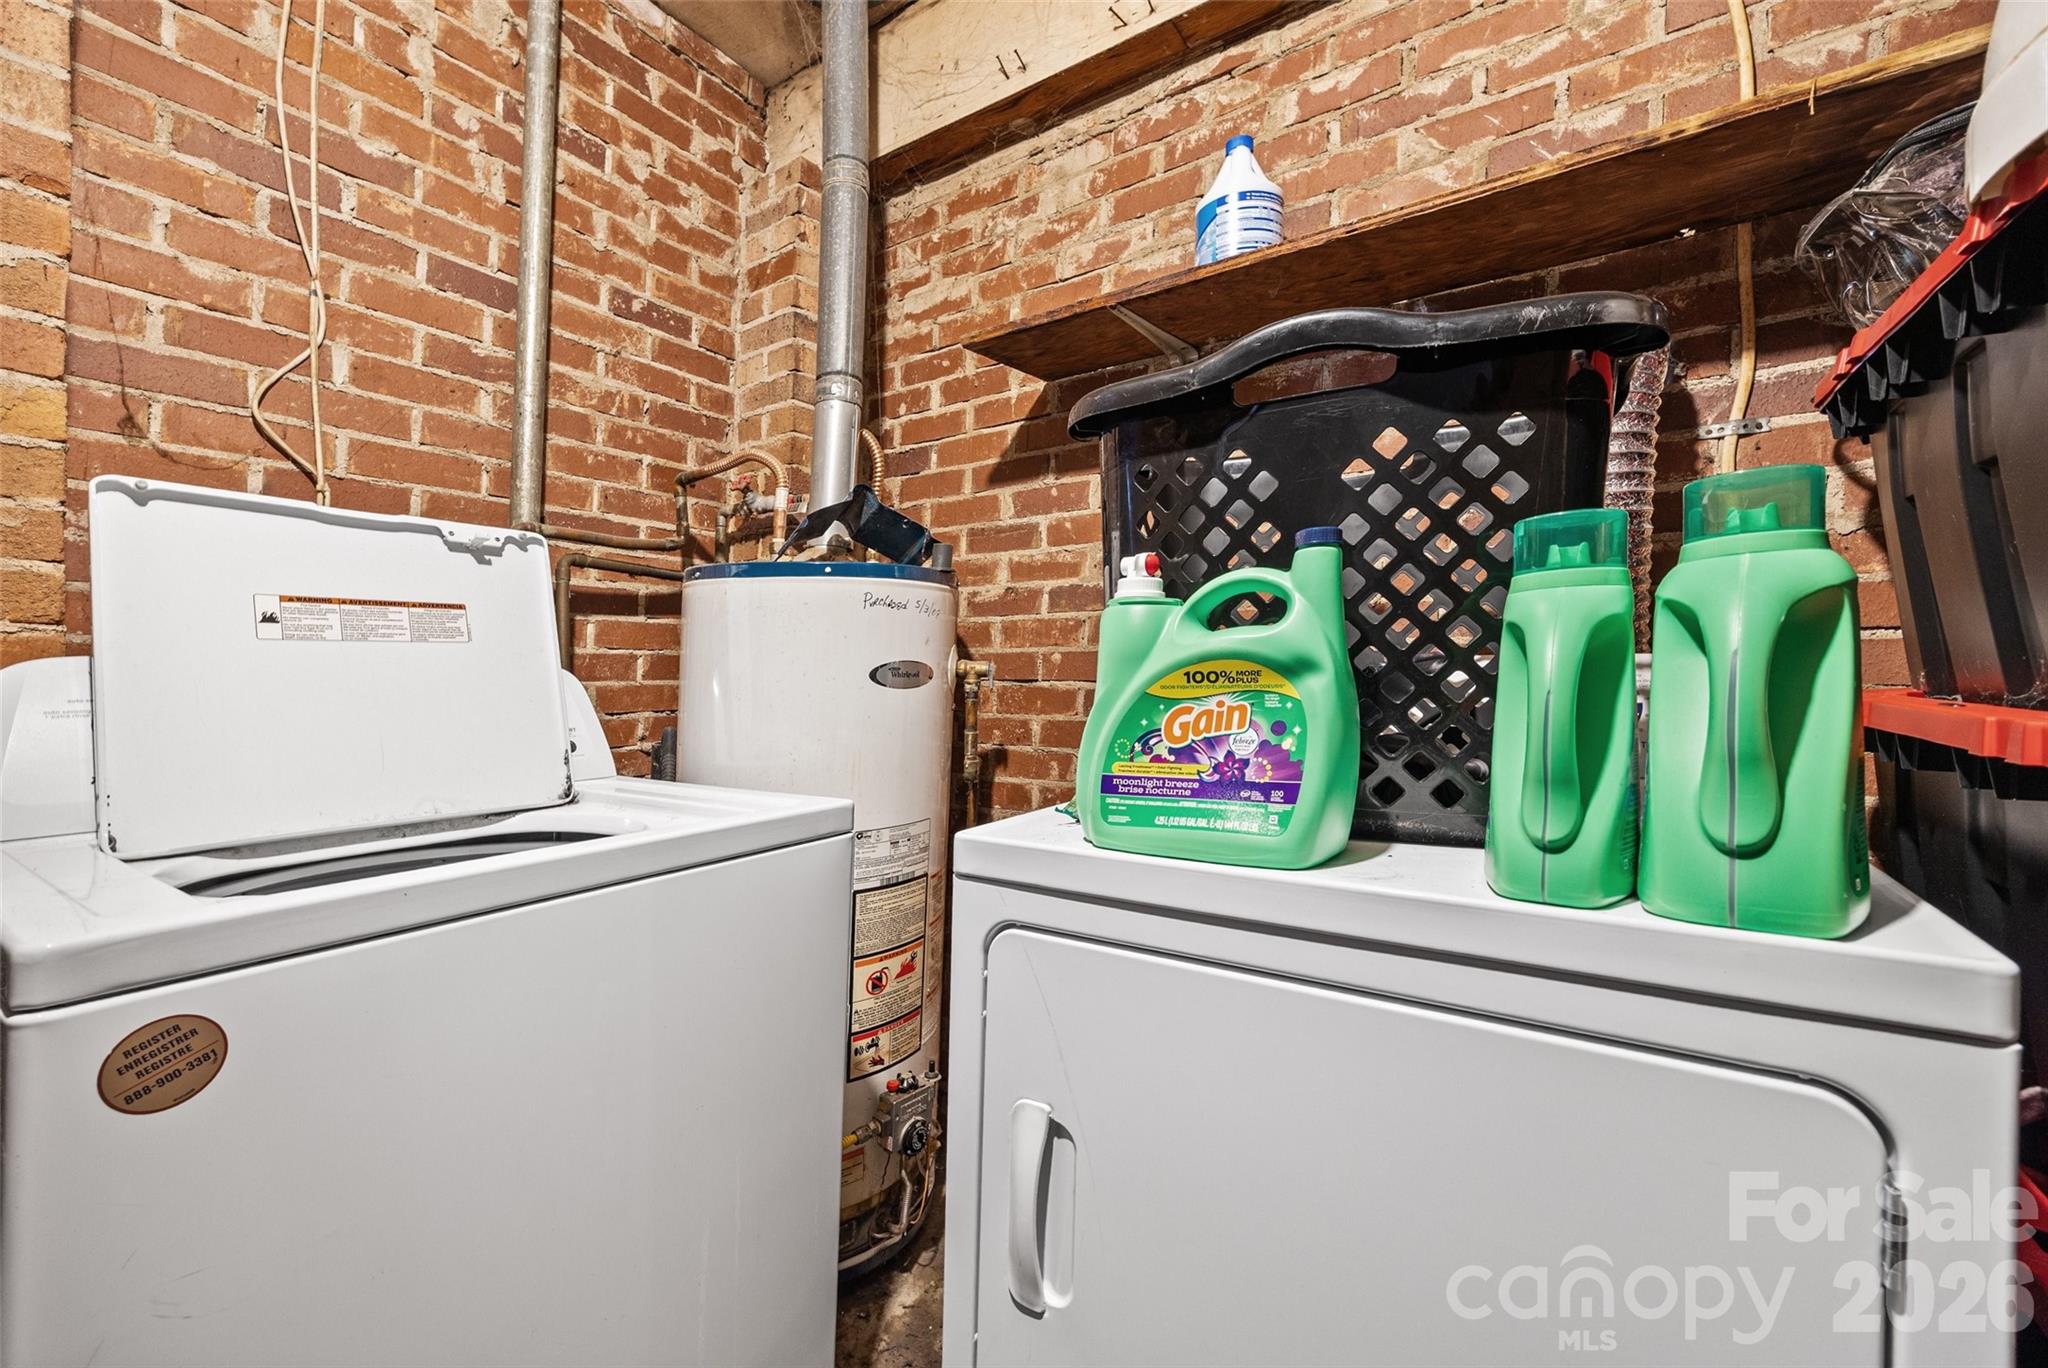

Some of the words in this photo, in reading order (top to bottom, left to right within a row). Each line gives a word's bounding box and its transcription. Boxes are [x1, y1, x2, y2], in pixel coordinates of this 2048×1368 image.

[294, 596, 333, 604] WARNING
[349, 599, 406, 607] AVERTISSEMENT
[1183, 670, 1236, 684] 100%
[1235, 669, 1263, 677] MORE
[1235, 676, 1260, 684] PLUS
[1163, 699, 1250, 747] Gain
[1112, 777, 1163, 788] moonlight
[1164, 778, 1200, 789] breeze
[1118, 785, 1144, 795] brise
[1145, 786, 1192, 796] nocturne
[1270, 790, 1284, 798] 100
[122, 1023, 182, 1060] REGISTER
[116, 1027, 199, 1077] ENREGISTRER
[135, 1043, 194, 1080] REGISTRE
[123, 1048, 218, 1105] 888-900-3381
